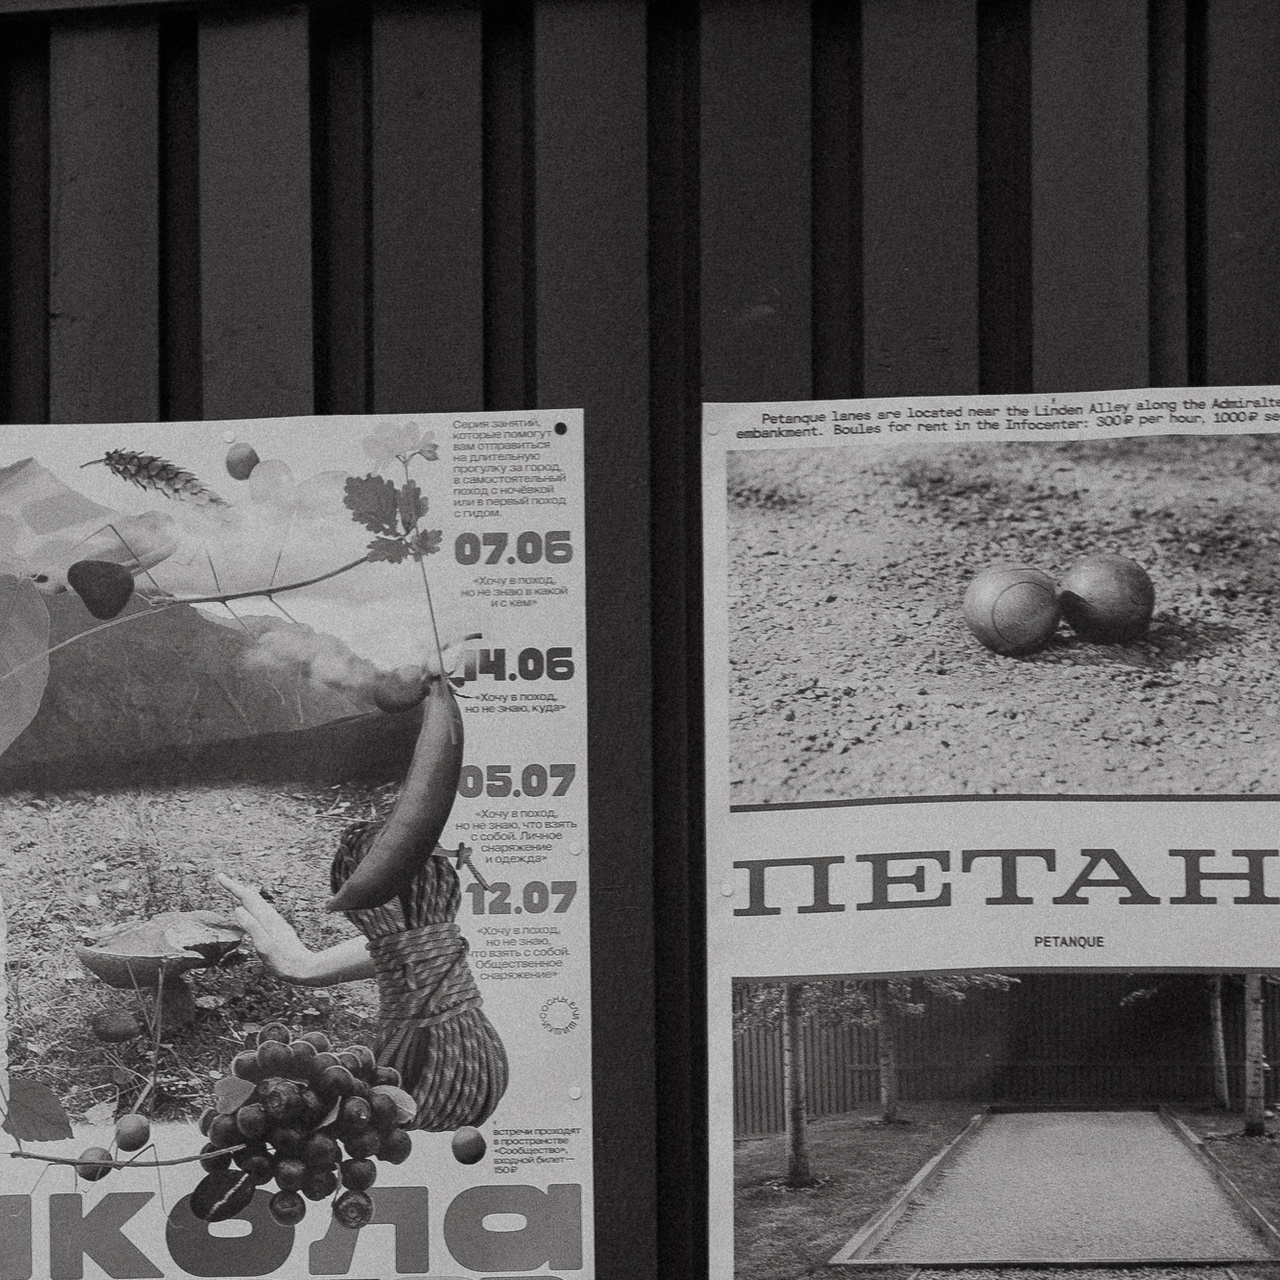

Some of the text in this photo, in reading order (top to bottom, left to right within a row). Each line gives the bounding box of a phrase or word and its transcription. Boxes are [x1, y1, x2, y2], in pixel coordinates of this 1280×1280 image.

[762, 414, 826, 424] Petanque
[832, 412, 870, 421] lanes
[878, 409, 901, 419] are
[908, 408, 962, 418] located
[1007, 408, 1029, 416] the
[1035, 407, 1083, 416] Linden
[1090, 403, 1129, 413] Alley
[1137, 400, 1176, 412] along
[1183, 401, 1206, 409] the
[737, 427, 824, 439] embankment.
[834, 423, 881, 435] Boules
[888, 422, 912, 432] for
[918, 423, 946, 431] rent
[977, 420, 999, 429] the
[1006, 419, 1088, 429] Infocenter:
[1139, 416, 1163, 424] per
[1170, 414, 1205, 423] hour,
[504, 431, 552, 439] помогут
[478, 442, 550, 450] отправиться
[470, 453, 540, 462] длительную
[525, 464, 562, 472] город,
[463, 474, 566, 484] самостоятельный
[486, 497, 529, 506] первый
[532, 497, 566, 505] поход
[463, 510, 501, 518] гидом.
[455, 531, 573, 565] 07.06
[534, 587, 568, 595] какой
[464, 647, 574, 681] 14.06
[458, 764, 576, 798] 05.07
[481, 844, 552, 853] снаряжение
[466, 880, 577, 915] 12.07
[1035, 936, 1104, 949] PETANQUE
[476, 960, 562, 969] Общественное
